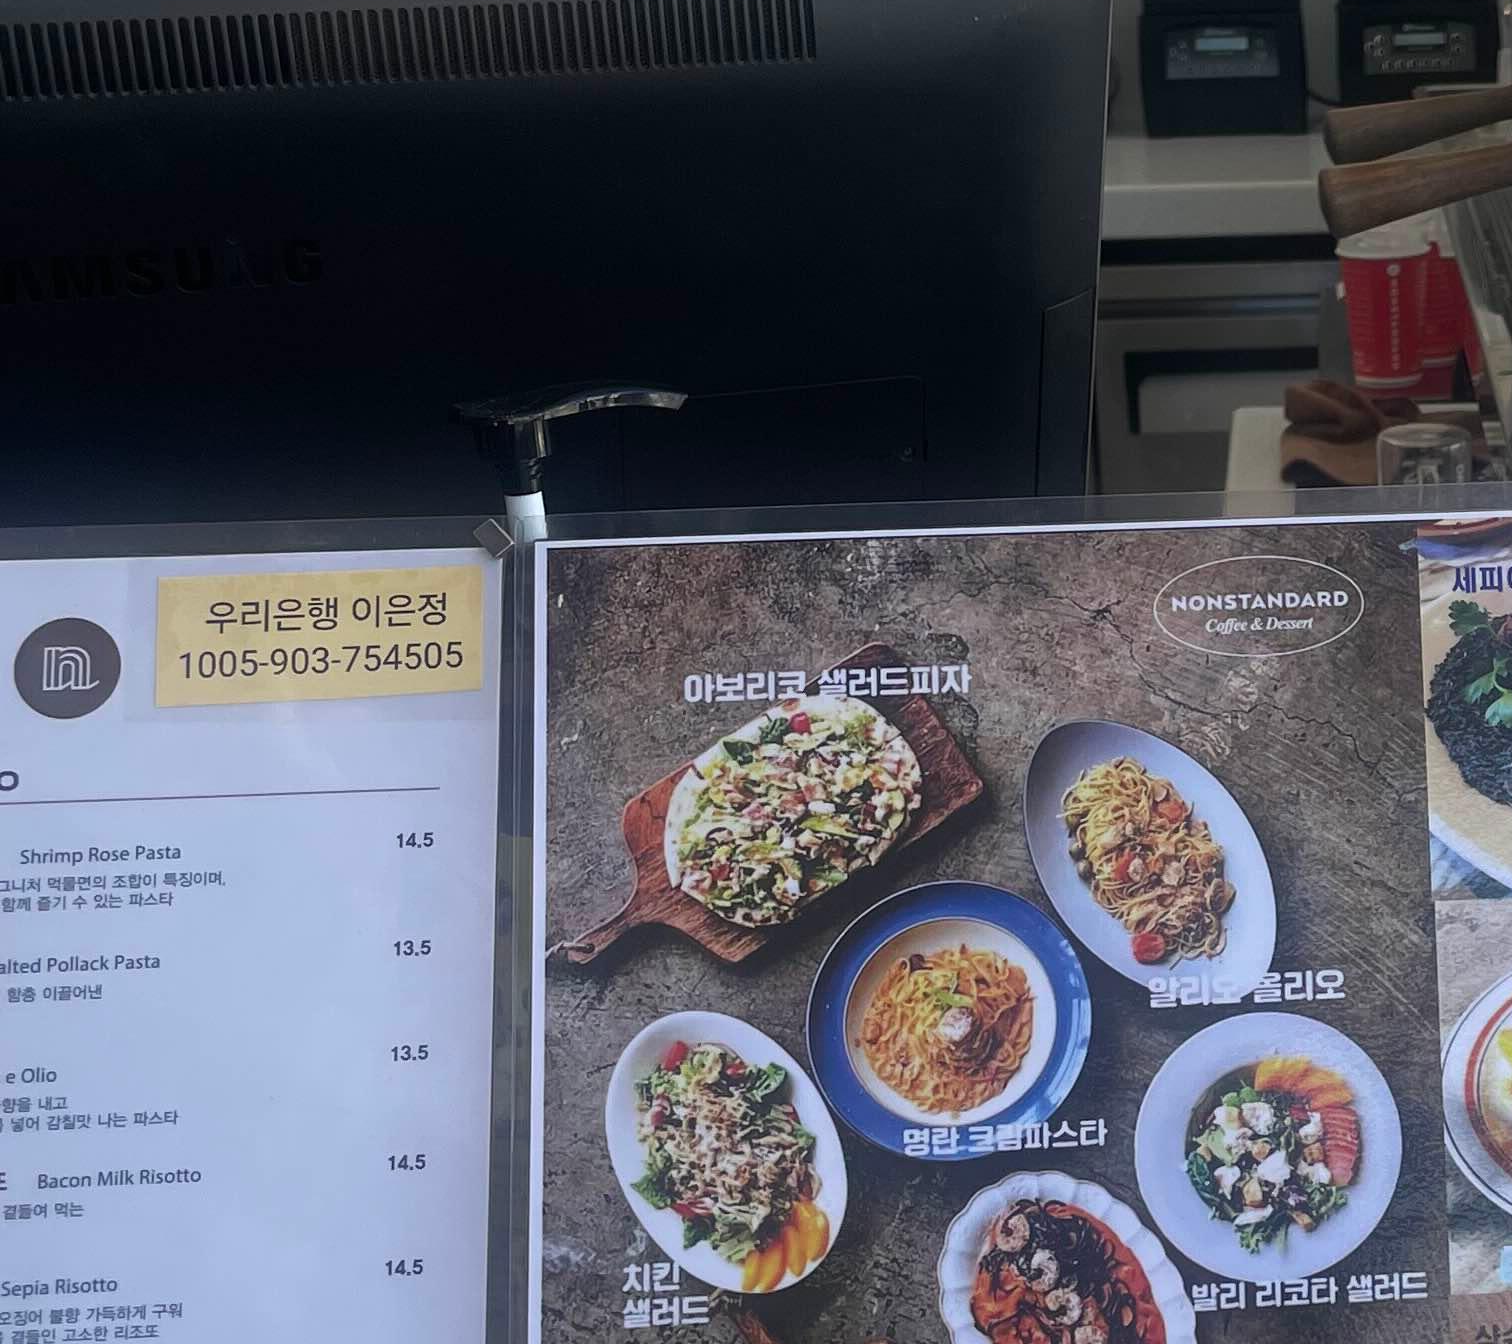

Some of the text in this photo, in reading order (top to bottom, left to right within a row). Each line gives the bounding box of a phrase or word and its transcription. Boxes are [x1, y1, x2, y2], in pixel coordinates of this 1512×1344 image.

[205, 592, 448, 634] 우리은행 이은정
[1171, 590, 1349, 612] NONSTANDARD
[1205, 615, 1314, 634] Coffee & Dessert
[179, 641, 464, 680] 1005-903-754505
[817, 663, 972, 696] 샐러드피자
[20, 832, 434, 866] Shrimp Rose Pasta 14.5
[112, 873, 157, 889] 조합이
[1, 891, 174, 913] 함께 즐기 수 있는 파스타
[47, 955, 109, 973] Pollack
[114, 955, 161, 970] Pasta
[393, 939, 432, 957] 13.5
[42, 983, 103, 1001] 이끌어낸
[1150, 969, 1346, 1008] 알리오 올리오
[21, 1067, 58, 1083] Olio
[391, 1044, 429, 1062] 13.5
[38, 1096, 68, 1111] 내고
[47, 1113, 91, 1131] 감칠맛
[98, 1112, 128, 1128] 나는
[133, 1110, 179, 1126] 파스타
[903, 1118, 1108, 1156] 명란 크림파스타
[37, 1154, 426, 1190] Bacon Milk Risotto 14.5
[3, 1201, 84, 1221] 곁들여 먹는
[1, 1259, 424, 1299] Sepia Risotto 14.5
[622, 1262, 680, 1292] 치킨
[1191, 1271, 1428, 1312] 발리 리코타 샐러드
[86, 1305, 147, 1322] 가득하게
[152, 1303, 183, 1319] 구워
[623, 1296, 710, 1328] 샐러드
[62, 1326, 108, 1342] 고소한
[114, 1324, 160, 1340] 리조또
